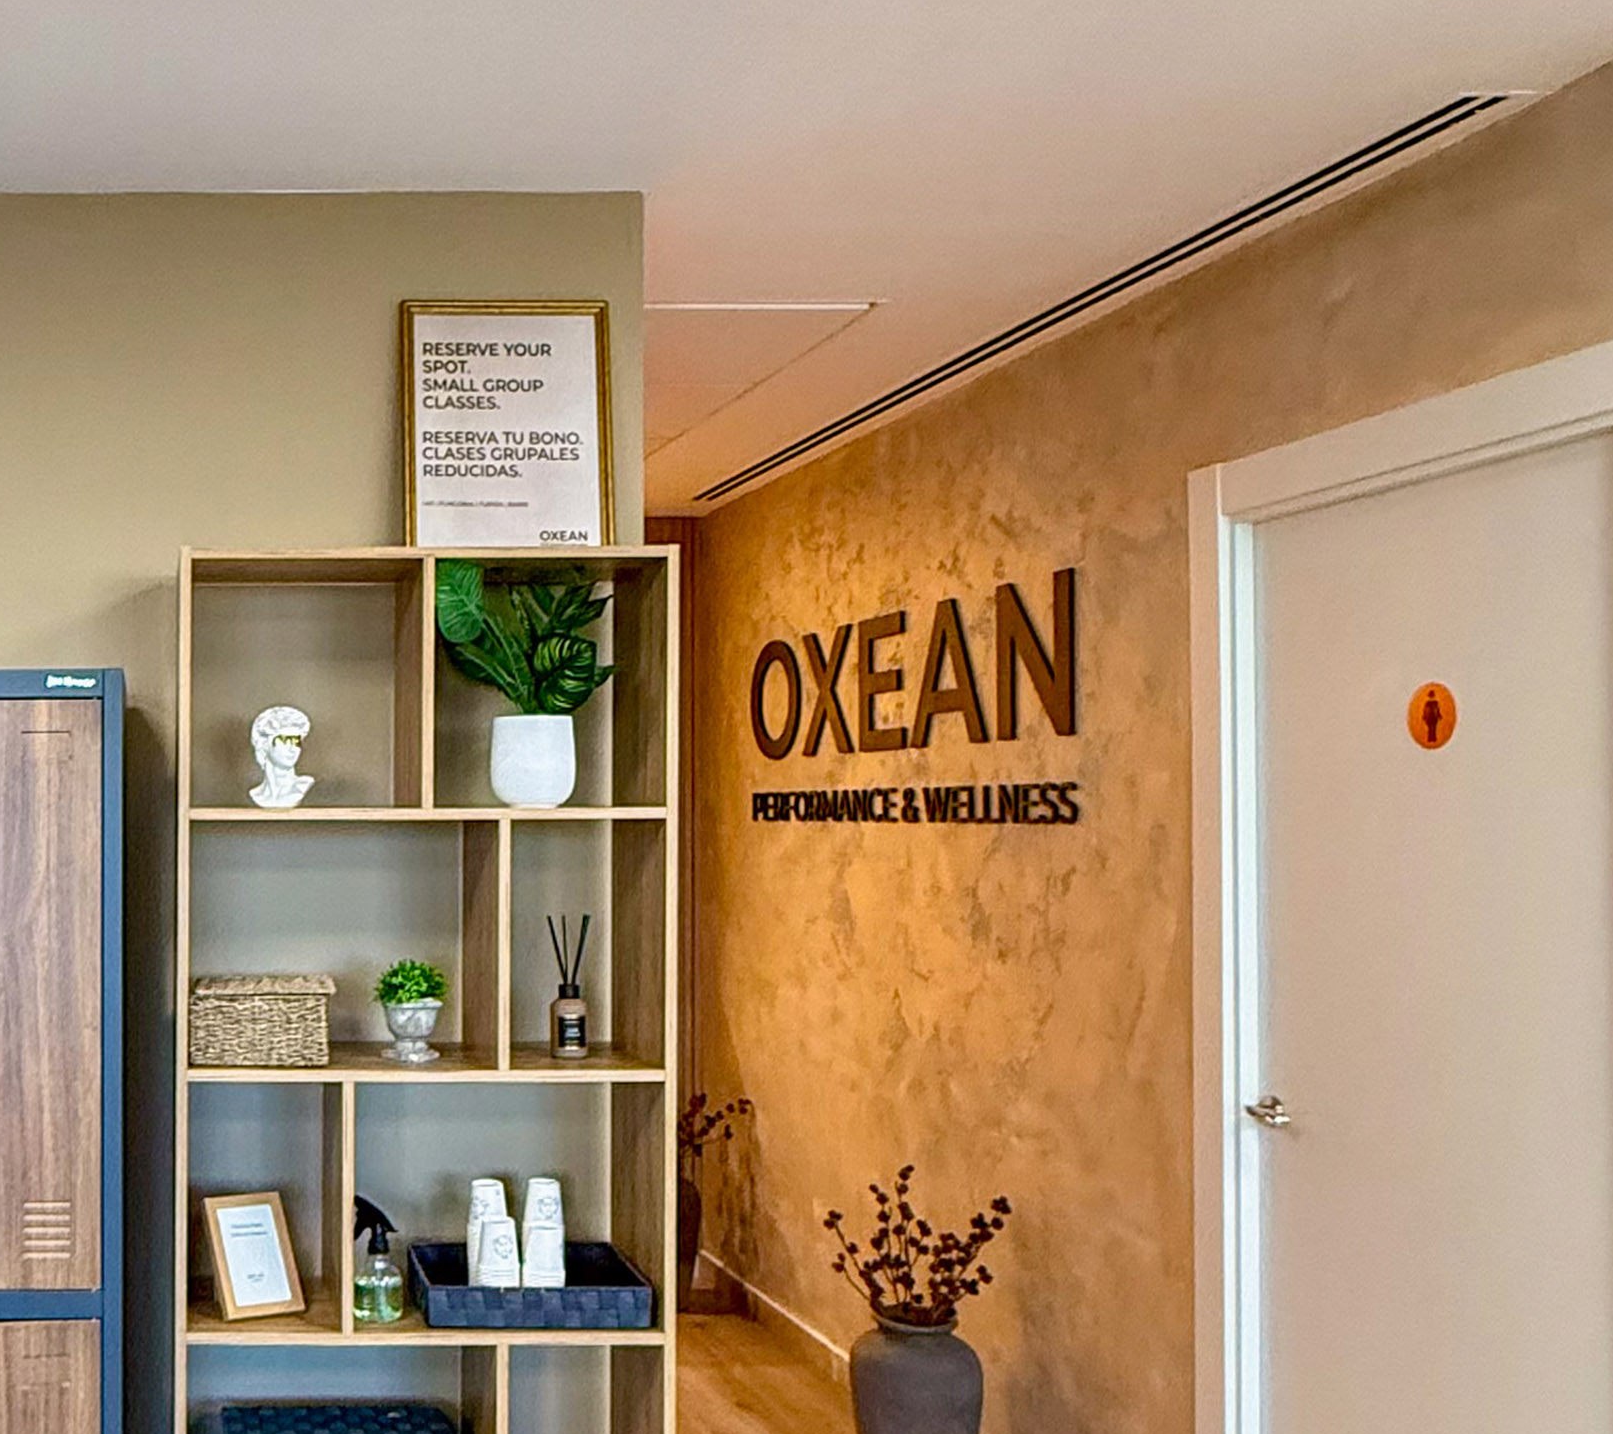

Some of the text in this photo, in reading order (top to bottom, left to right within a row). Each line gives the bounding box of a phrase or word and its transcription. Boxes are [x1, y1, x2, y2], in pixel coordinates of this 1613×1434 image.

[422, 342, 552, 357] RESERVE YOUR
[422, 360, 471, 374] SPOT.
[422, 378, 544, 393] SMALL GROUP
[422, 395, 501, 410] CLASSES.
[422, 431, 584, 446] RESERVA TU BONO.
[422, 447, 580, 461] CLASES GRUPALES
[422, 464, 522, 478] REDUCIDAS.
[539, 530, 588, 542] OXEAN
[750, 567, 1076, 760] OXEAN
[752, 781, 1079, 825] PERFORMANCE & WELLNESS
